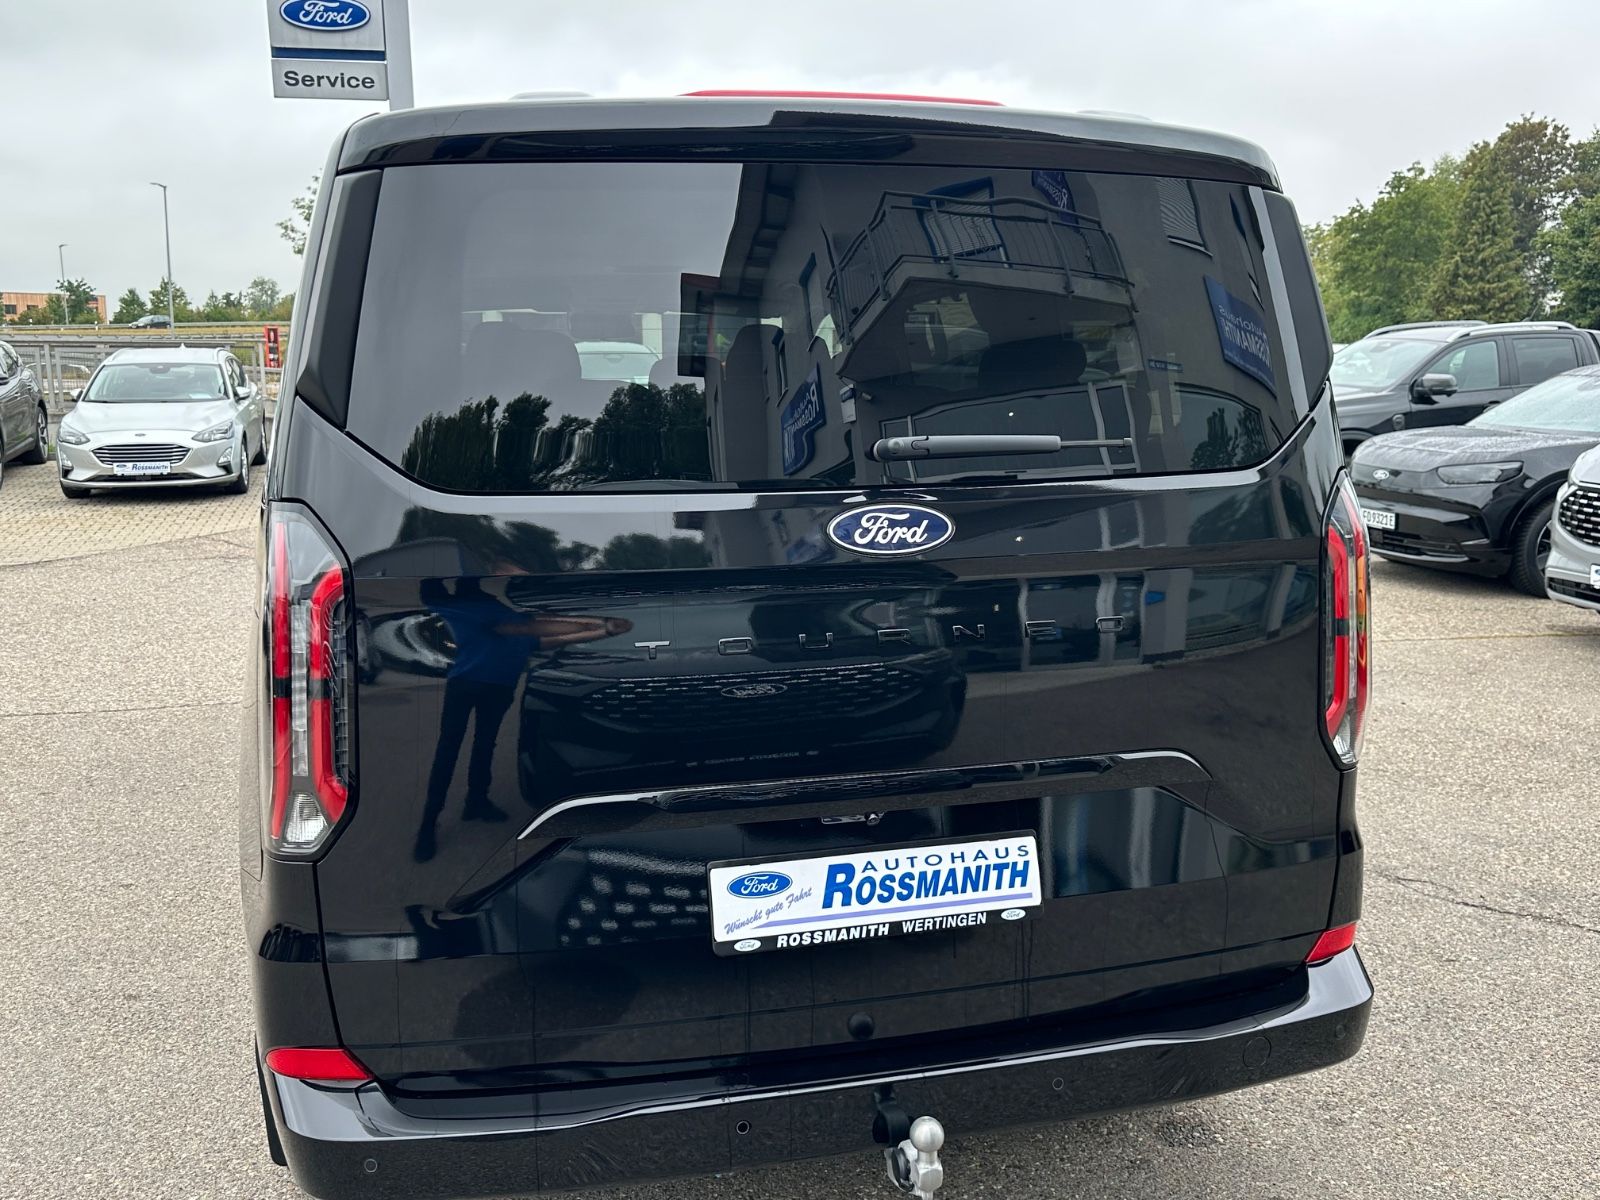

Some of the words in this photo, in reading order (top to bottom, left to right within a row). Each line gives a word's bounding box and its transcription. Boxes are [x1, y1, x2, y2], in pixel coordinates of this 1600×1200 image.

[299, 0, 353, 24] Ford
[284, 70, 375, 89] Service
[854, 512, 929, 545] Ford
[861, 845, 1030, 873] AUTOHAUS
[740, 875, 779, 894] Ford
[821, 860, 1030, 909] ROSSMANITH
[724, 909, 763, 935] Wünscht
[765, 901, 784, 920] gute
[786, 886, 813, 909] Fahrt
[776, 922, 890, 948] ROSSMANITH
[901, 912, 987, 934] WERTINGEN
